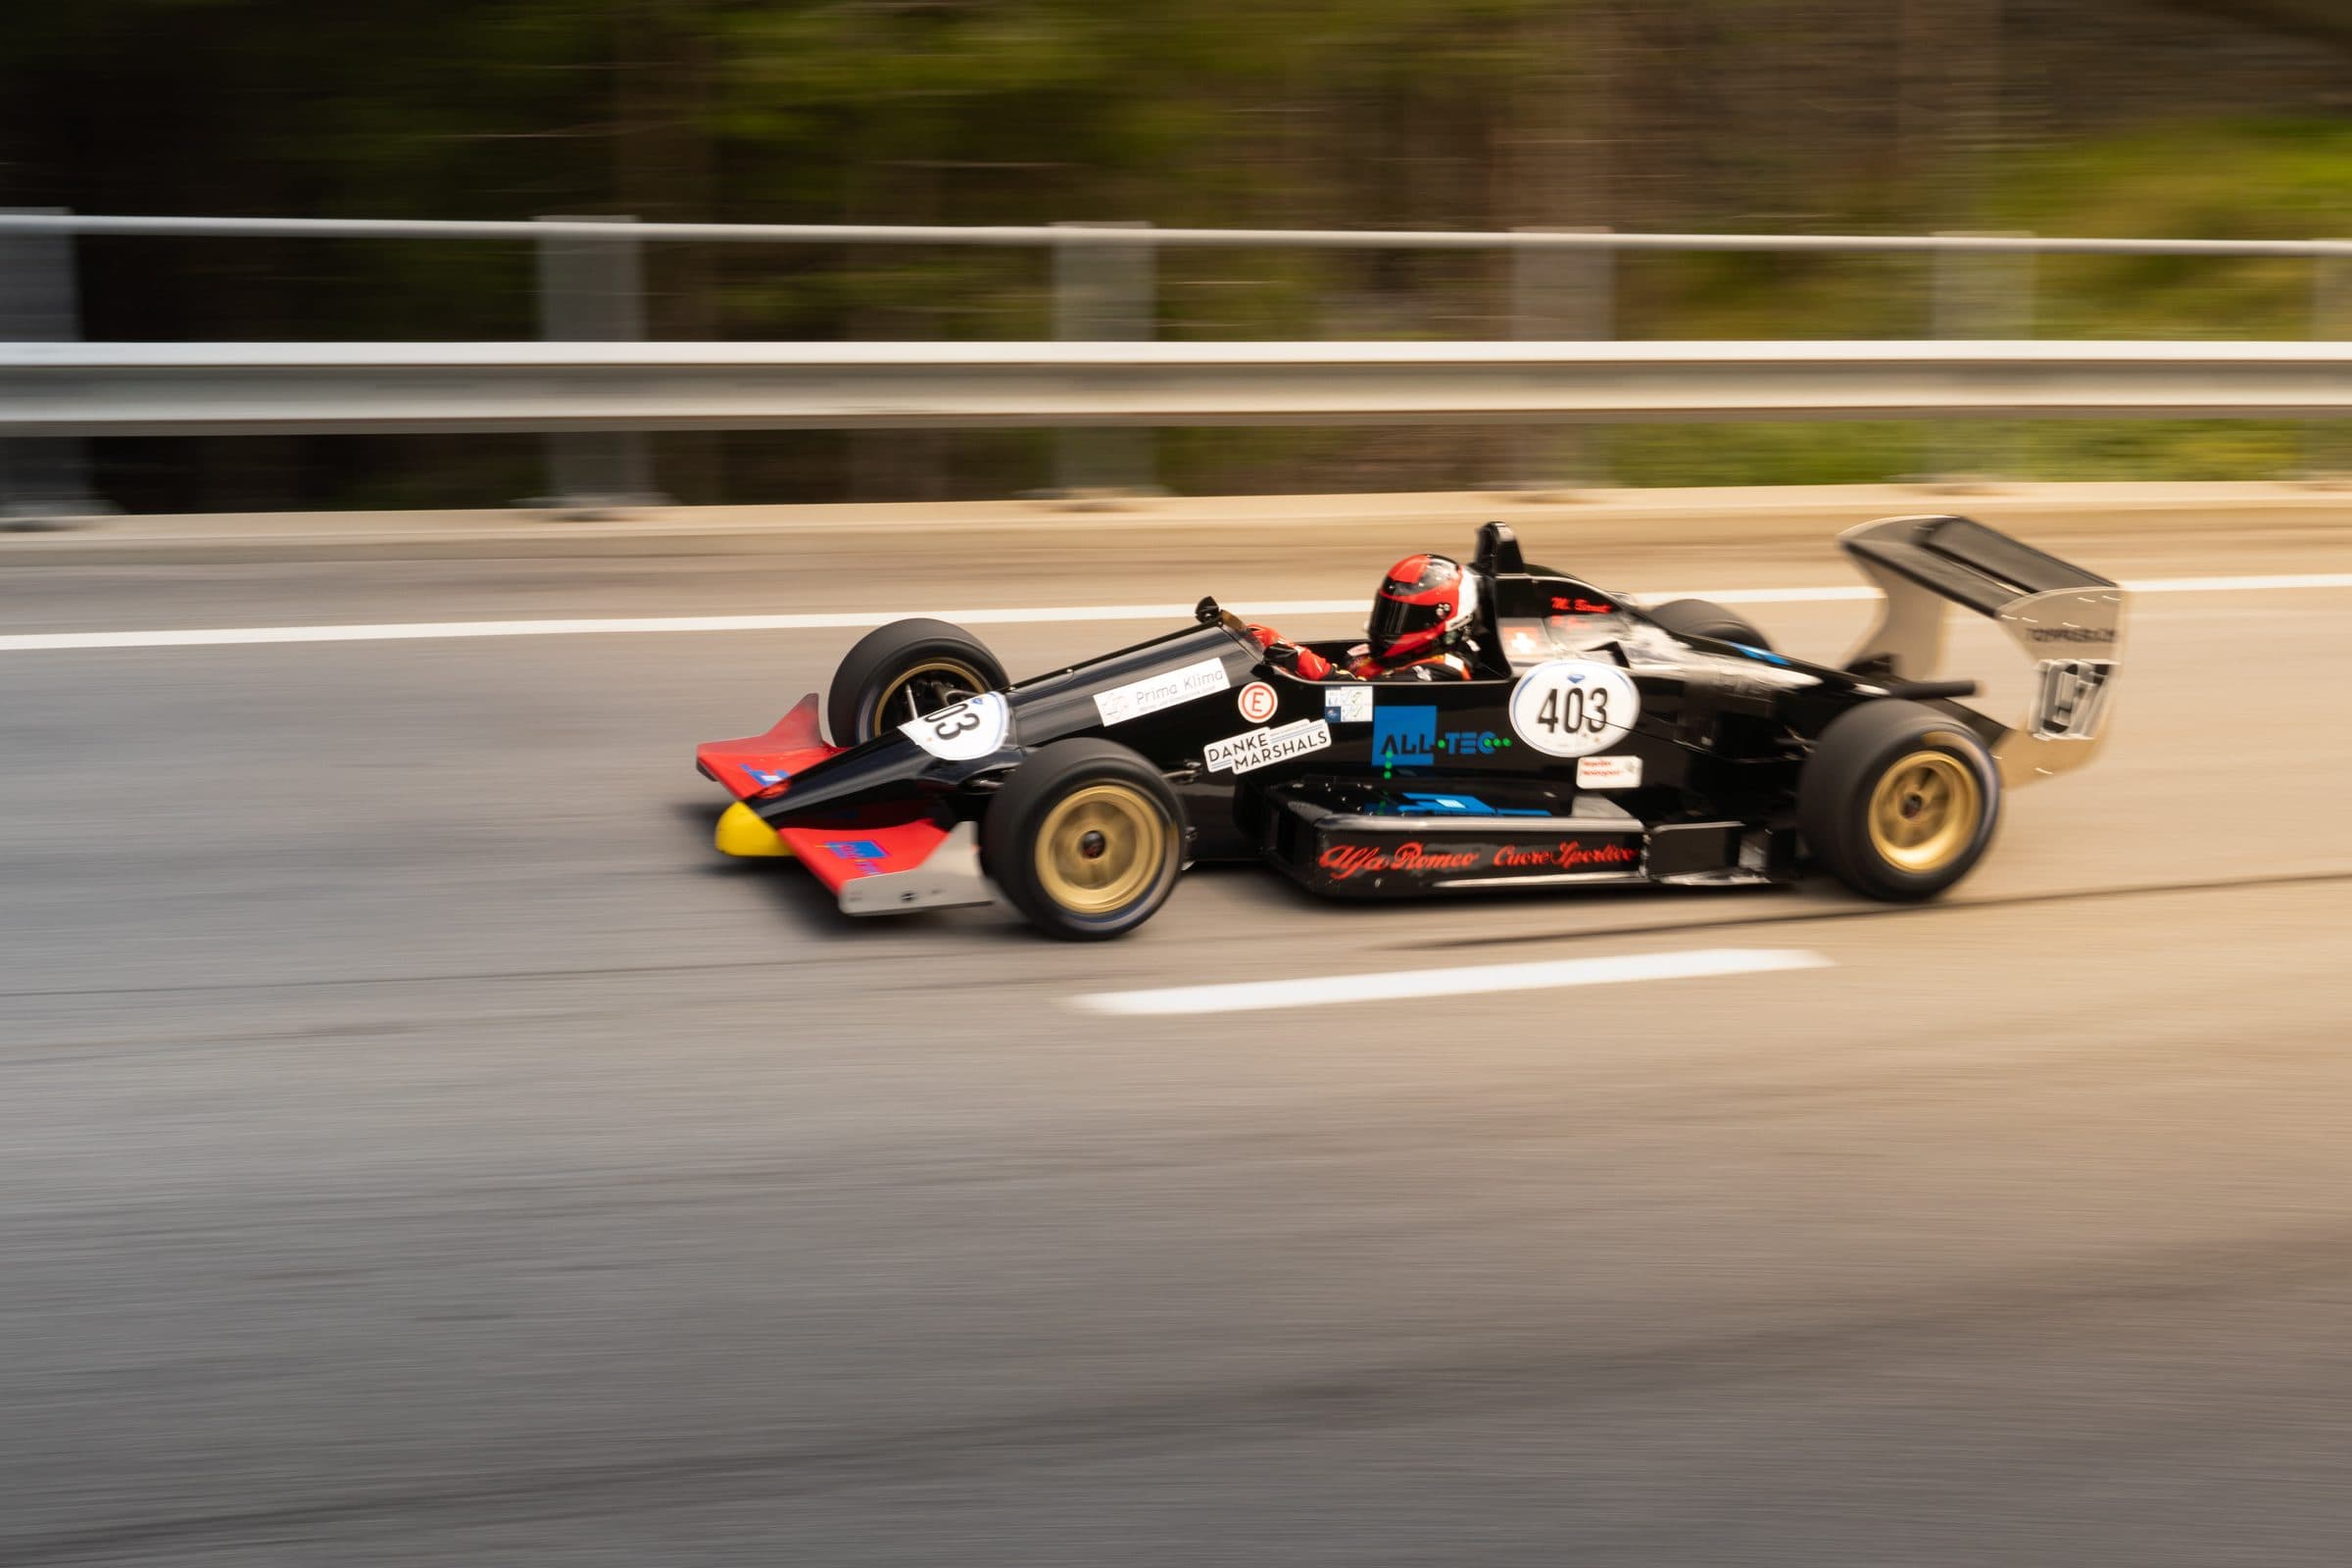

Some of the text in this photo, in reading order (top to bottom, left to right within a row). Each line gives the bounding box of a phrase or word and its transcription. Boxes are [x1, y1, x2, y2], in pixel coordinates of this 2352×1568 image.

[1136, 683, 1178, 706] Prima
[1183, 669, 1224, 692] Klima
[1251, 691, 1265, 712] E
[1536, 687, 1608, 734] 403
[1207, 732, 1269, 762] DANKE
[1234, 730, 1328, 770] MARSHALS
[1318, 841, 1481, 880] Alfa Romeo
